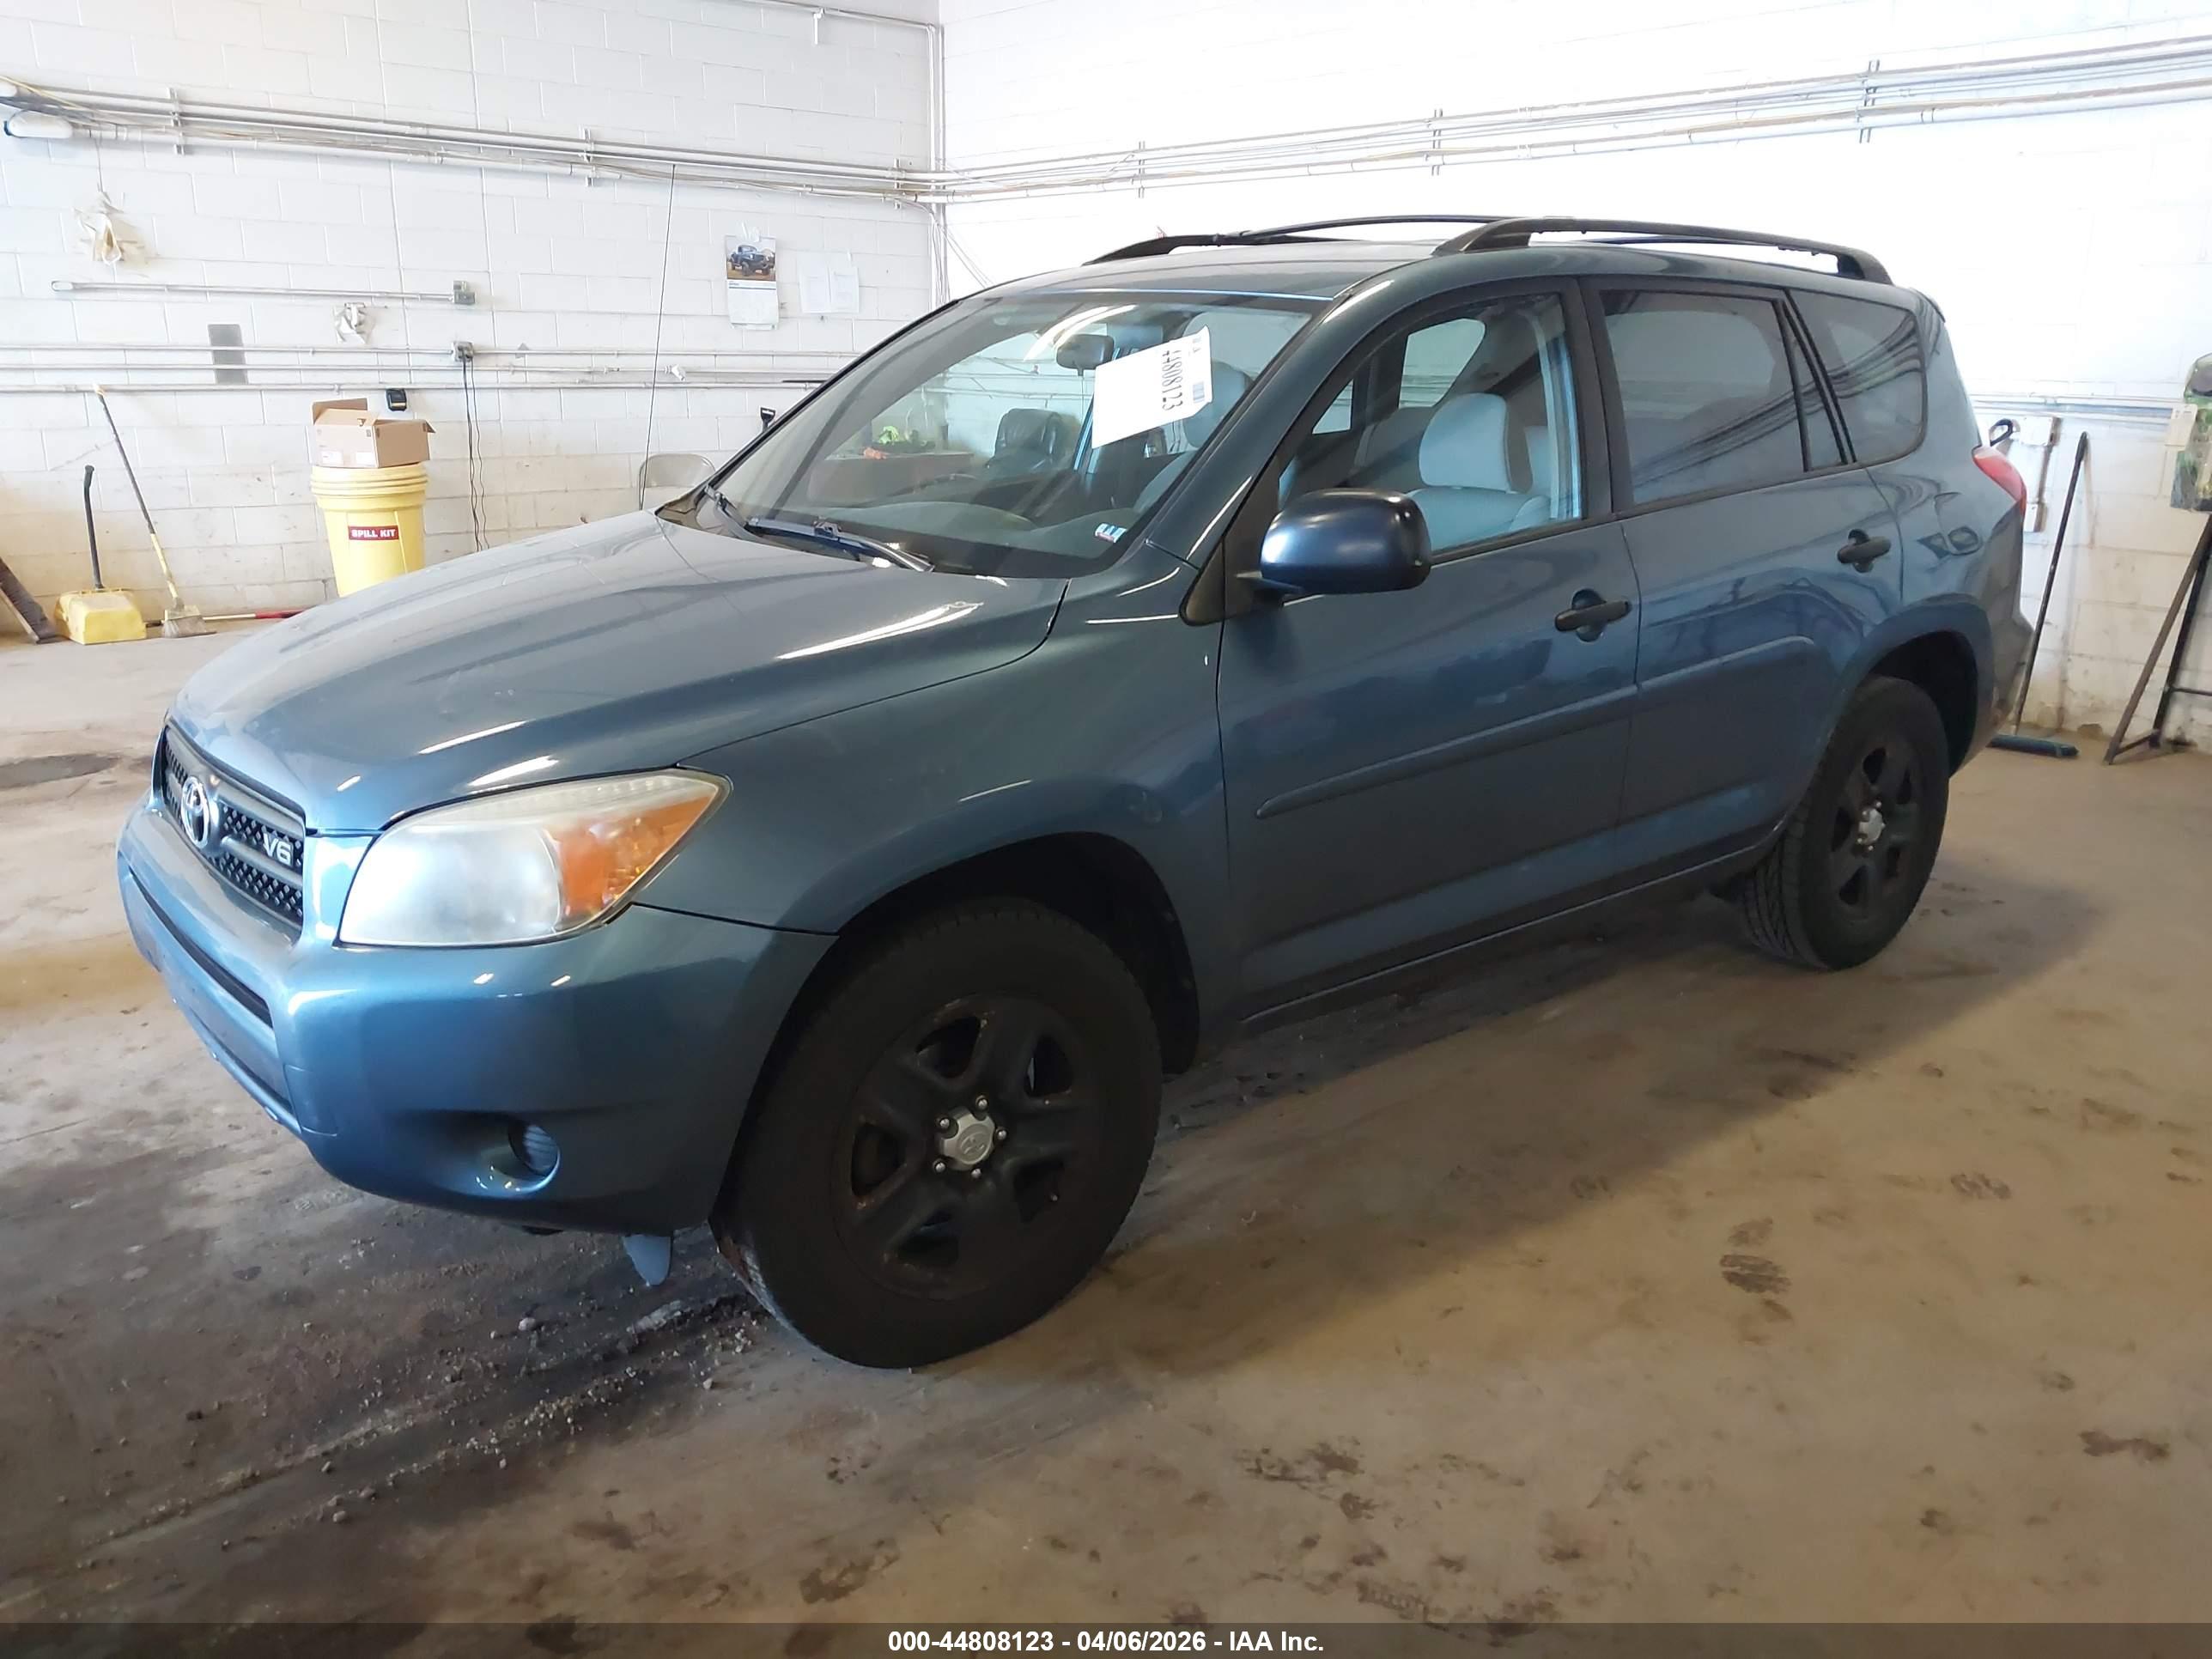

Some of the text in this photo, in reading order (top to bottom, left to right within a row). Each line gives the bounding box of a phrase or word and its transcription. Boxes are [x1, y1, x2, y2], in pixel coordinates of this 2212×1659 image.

[1162, 350, 1183, 410] 44808123
[351, 529, 396, 538] SPILL KIT
[263, 832, 294, 866] V6
